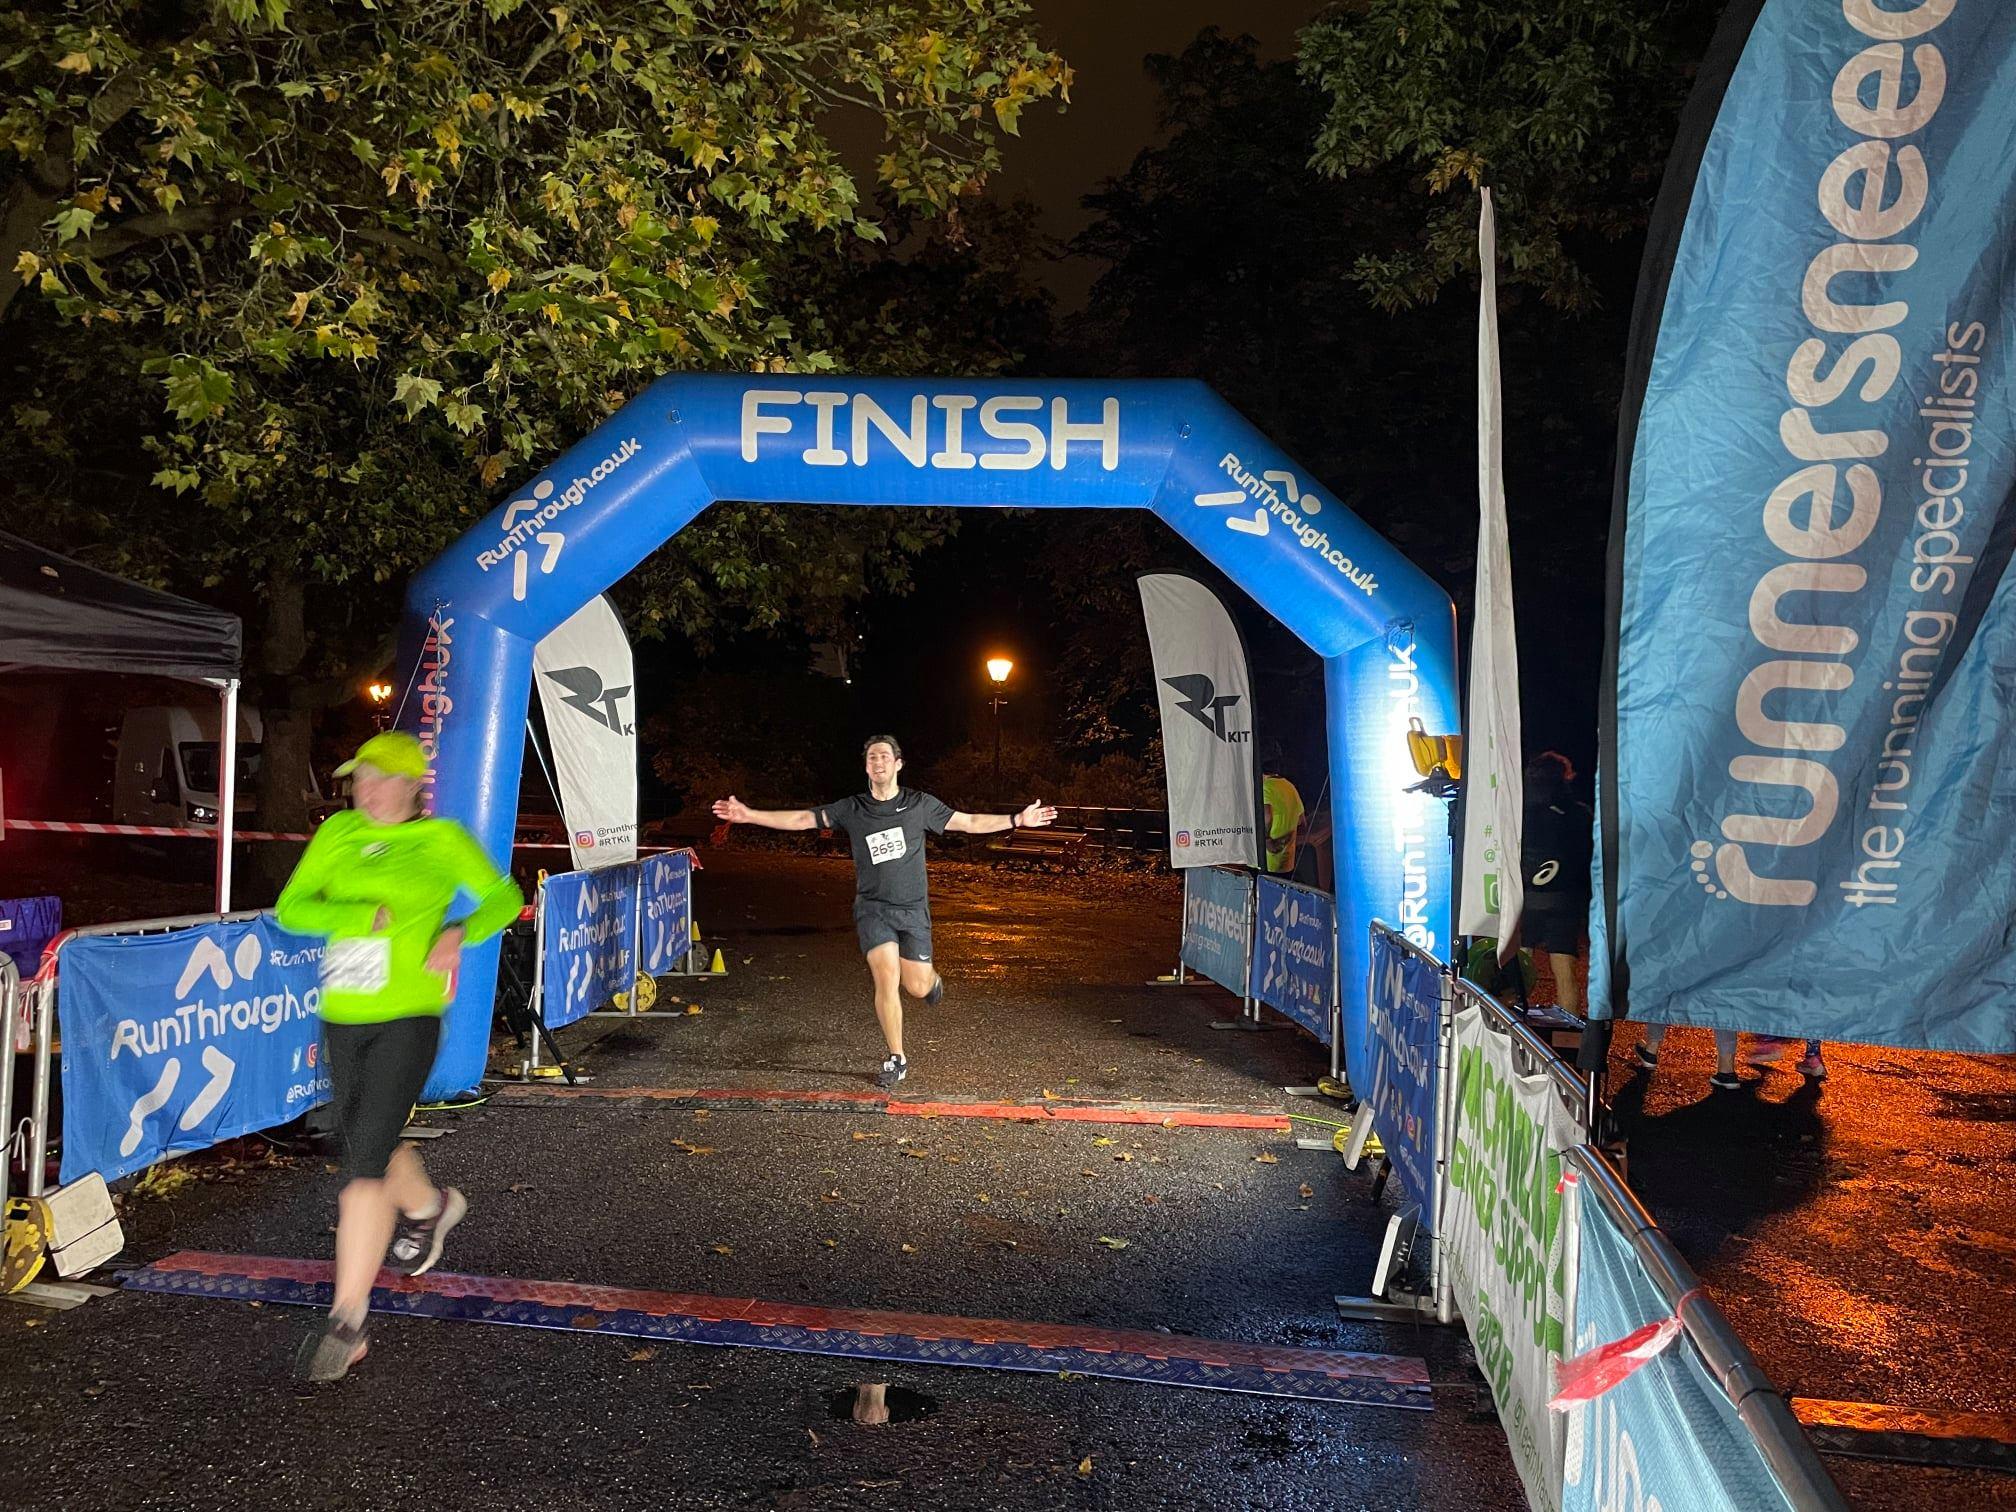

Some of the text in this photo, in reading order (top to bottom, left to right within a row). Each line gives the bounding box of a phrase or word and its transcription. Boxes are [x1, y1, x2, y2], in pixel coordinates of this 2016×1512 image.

[741, 389, 1120, 471] FINISH
[476, 437, 642, 571] RunThrough.co.uk
[1219, 452, 1378, 596] RunThrough.co.uk
[1840, 321, 1985, 907] the running specialists
[1227, 730, 1251, 744] KIT
[599, 835, 630, 847] #RTKit
[871, 840, 904, 857] 2693
